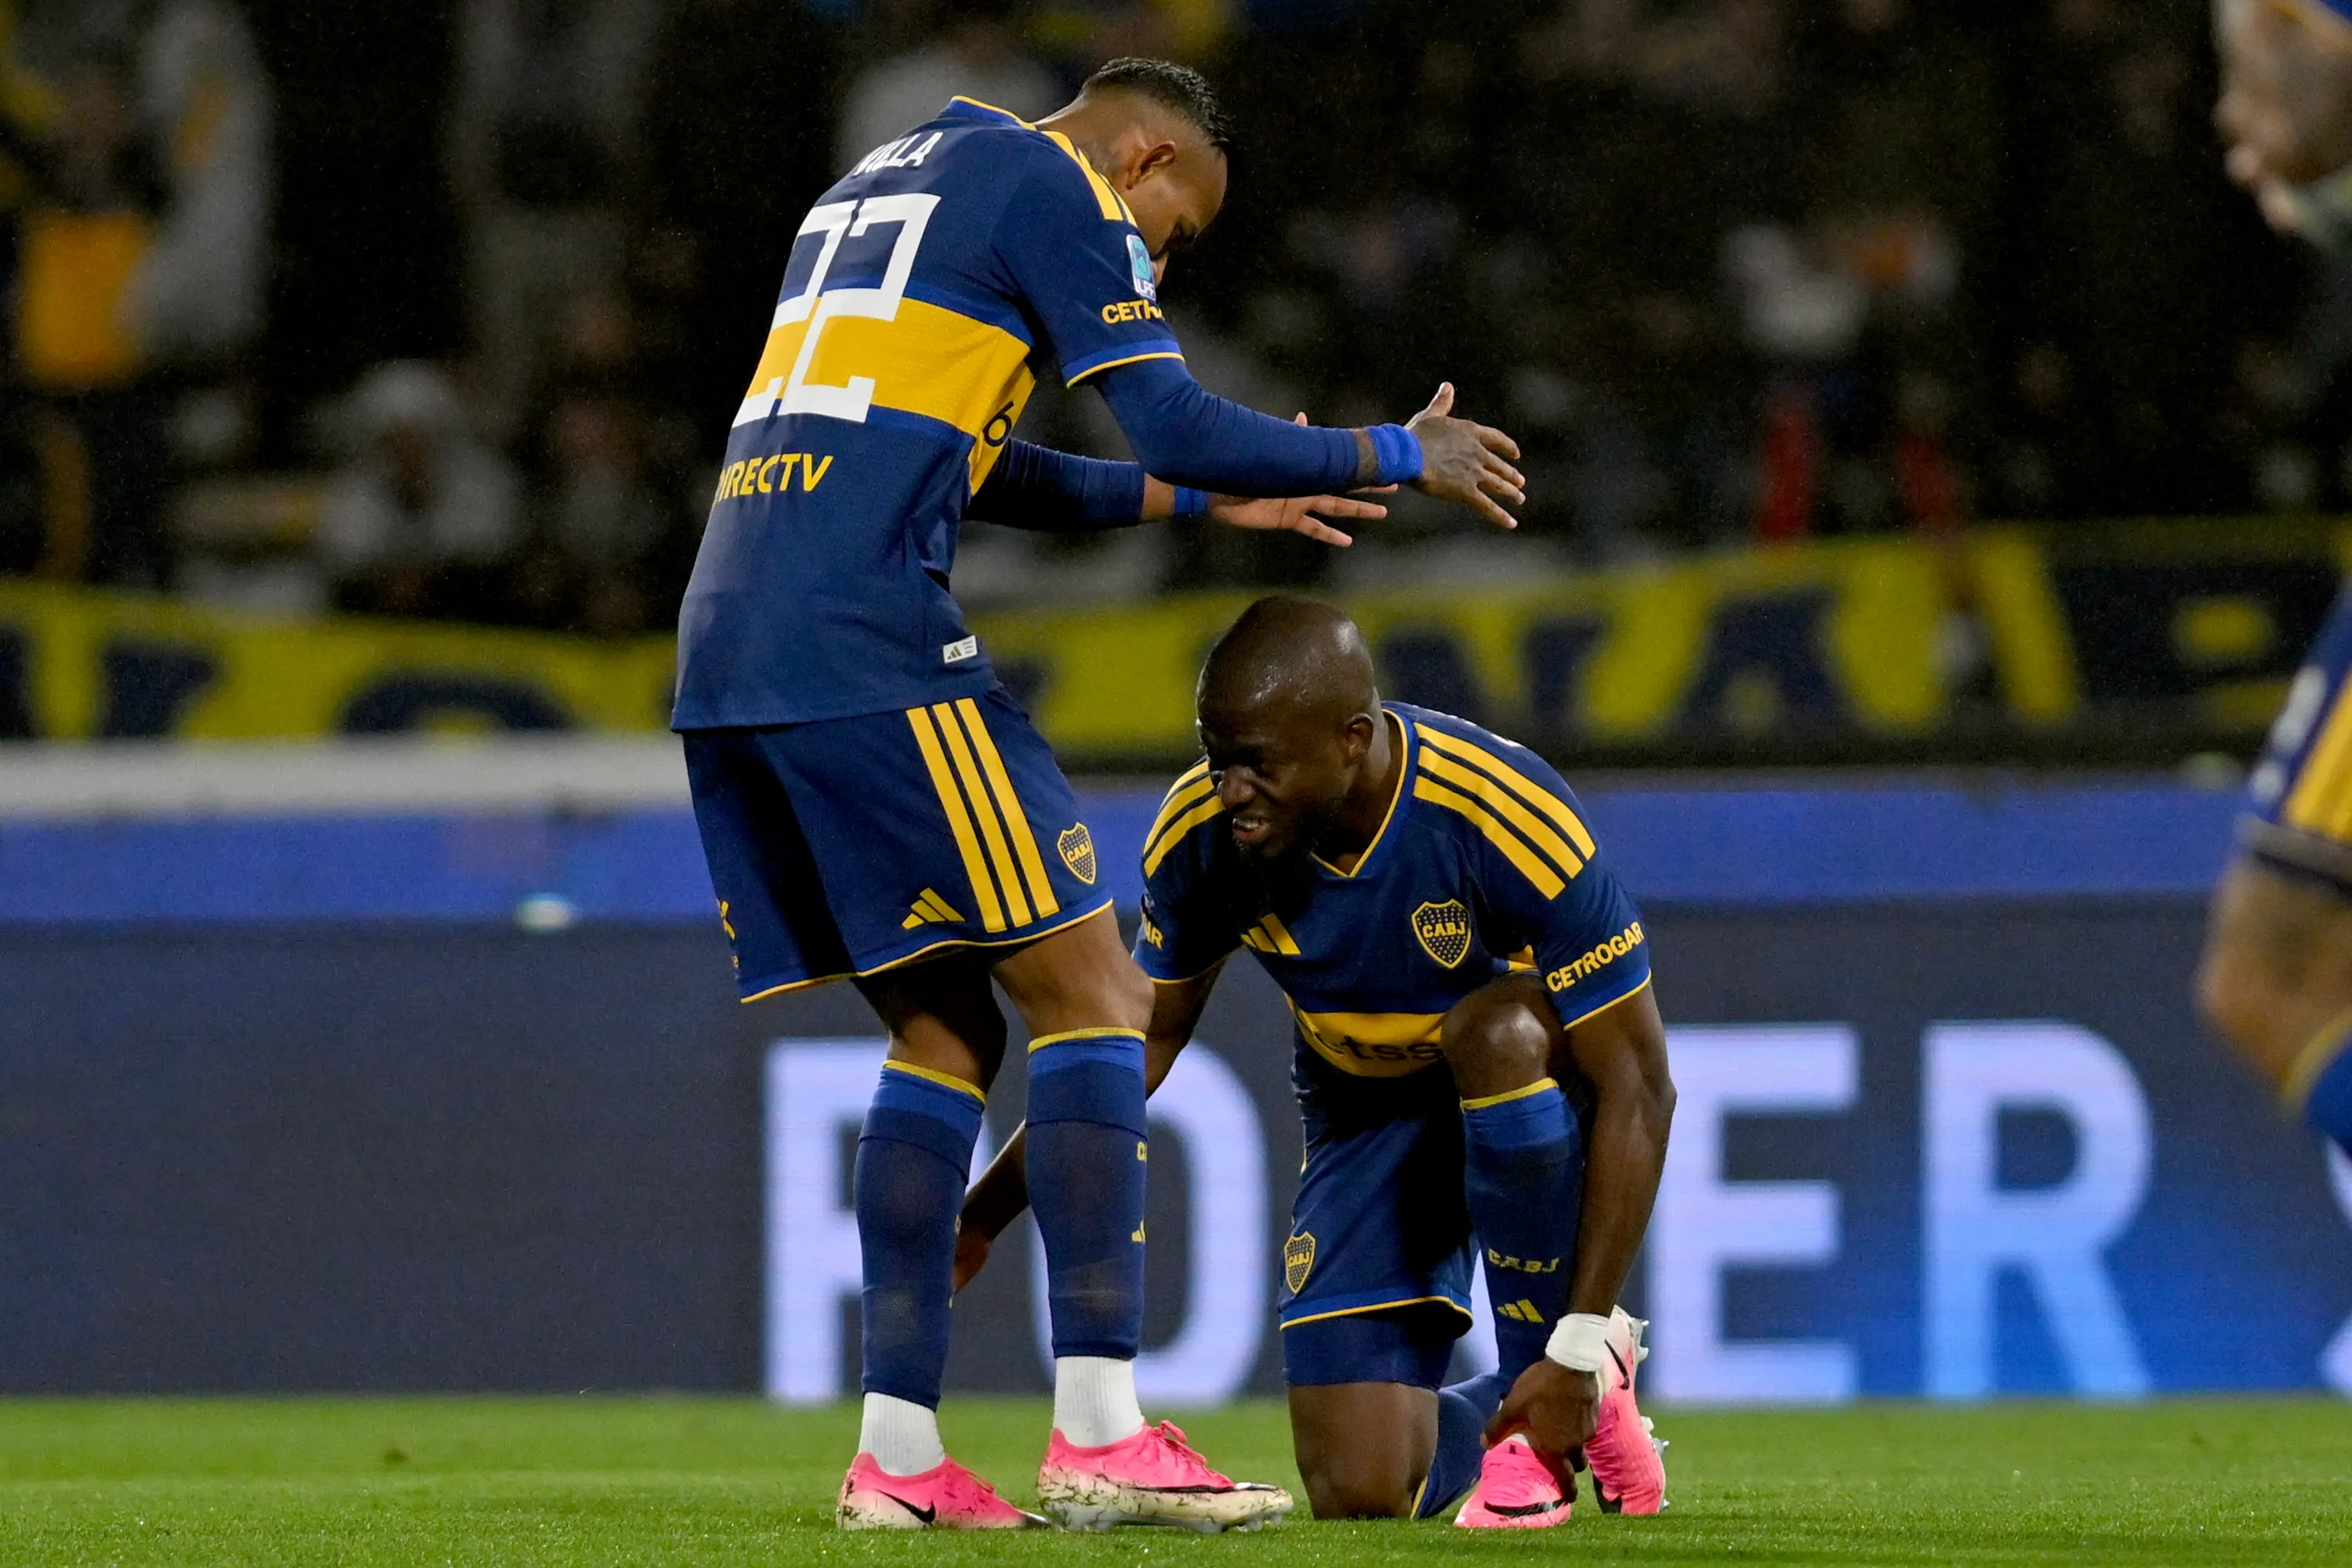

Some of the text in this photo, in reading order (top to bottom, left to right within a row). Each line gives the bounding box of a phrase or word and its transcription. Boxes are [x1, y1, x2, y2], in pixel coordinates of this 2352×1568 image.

[731, 193, 942, 429] 22
[1067, 840, 1091, 862] CABJ
[1422, 921, 1465, 938] CABJ
[1546, 921, 1645, 993] CETROGAR
[763, 1021, 2156, 1406] POER
[1288, 1251, 1310, 1268] CABJ
[1488, 1248, 1560, 1273] CABJ
